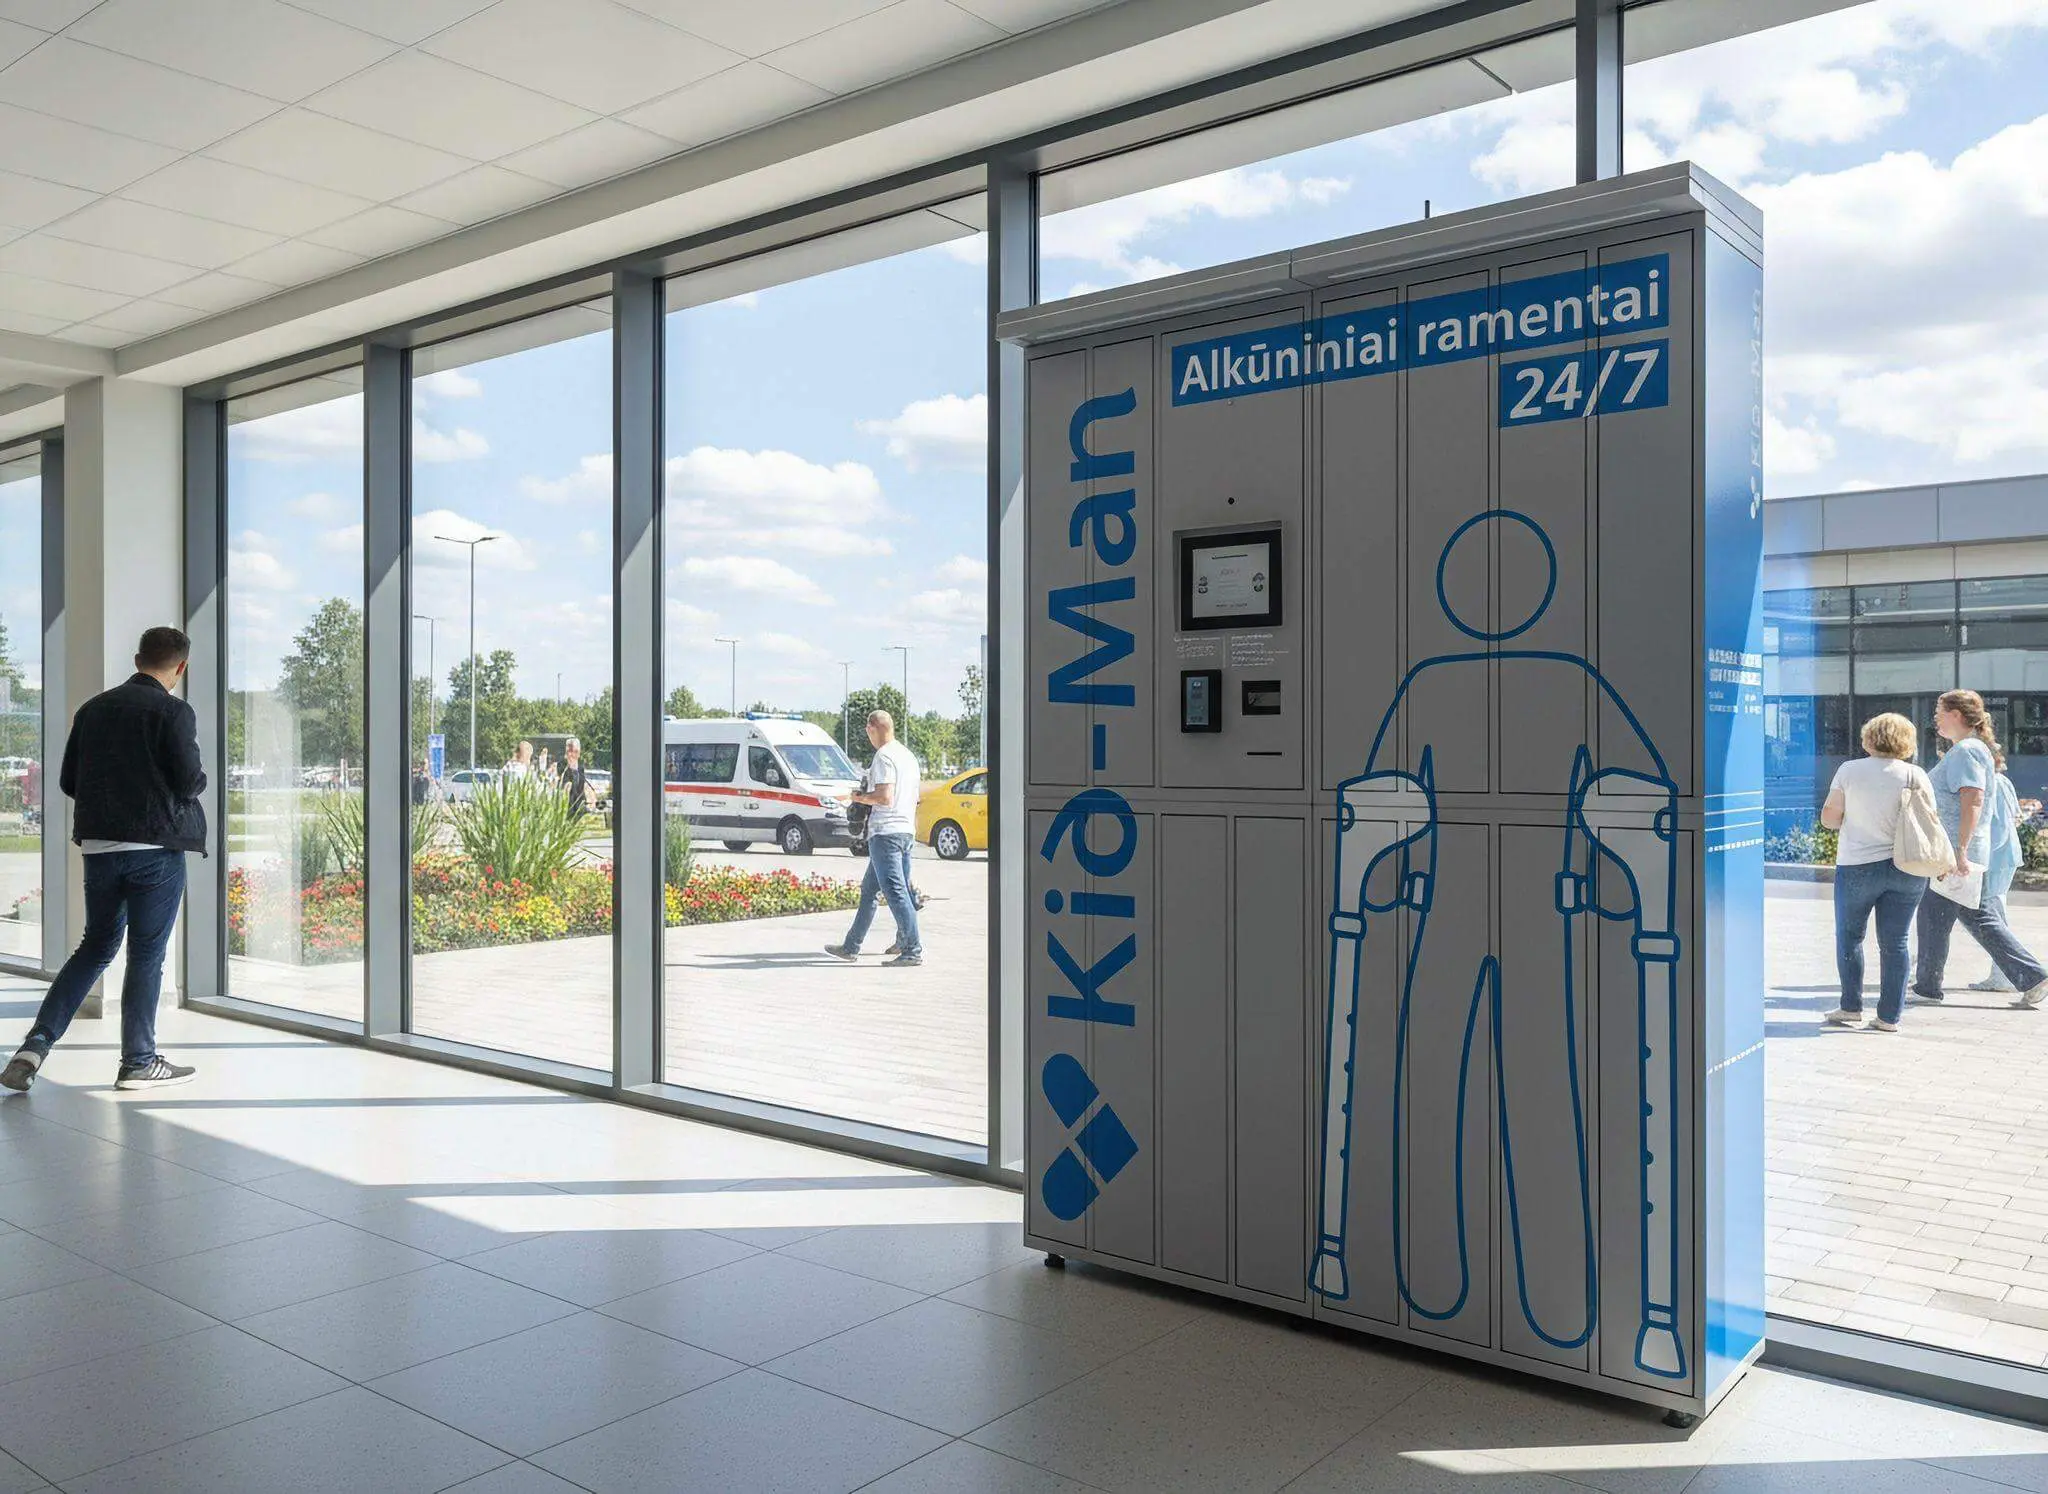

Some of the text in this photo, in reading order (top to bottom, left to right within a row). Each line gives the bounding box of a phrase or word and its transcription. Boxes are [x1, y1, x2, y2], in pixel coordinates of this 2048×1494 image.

[1179, 270, 1659, 395] Alkūniniai ramentai
[1510, 348, 1659, 418] 24/7
